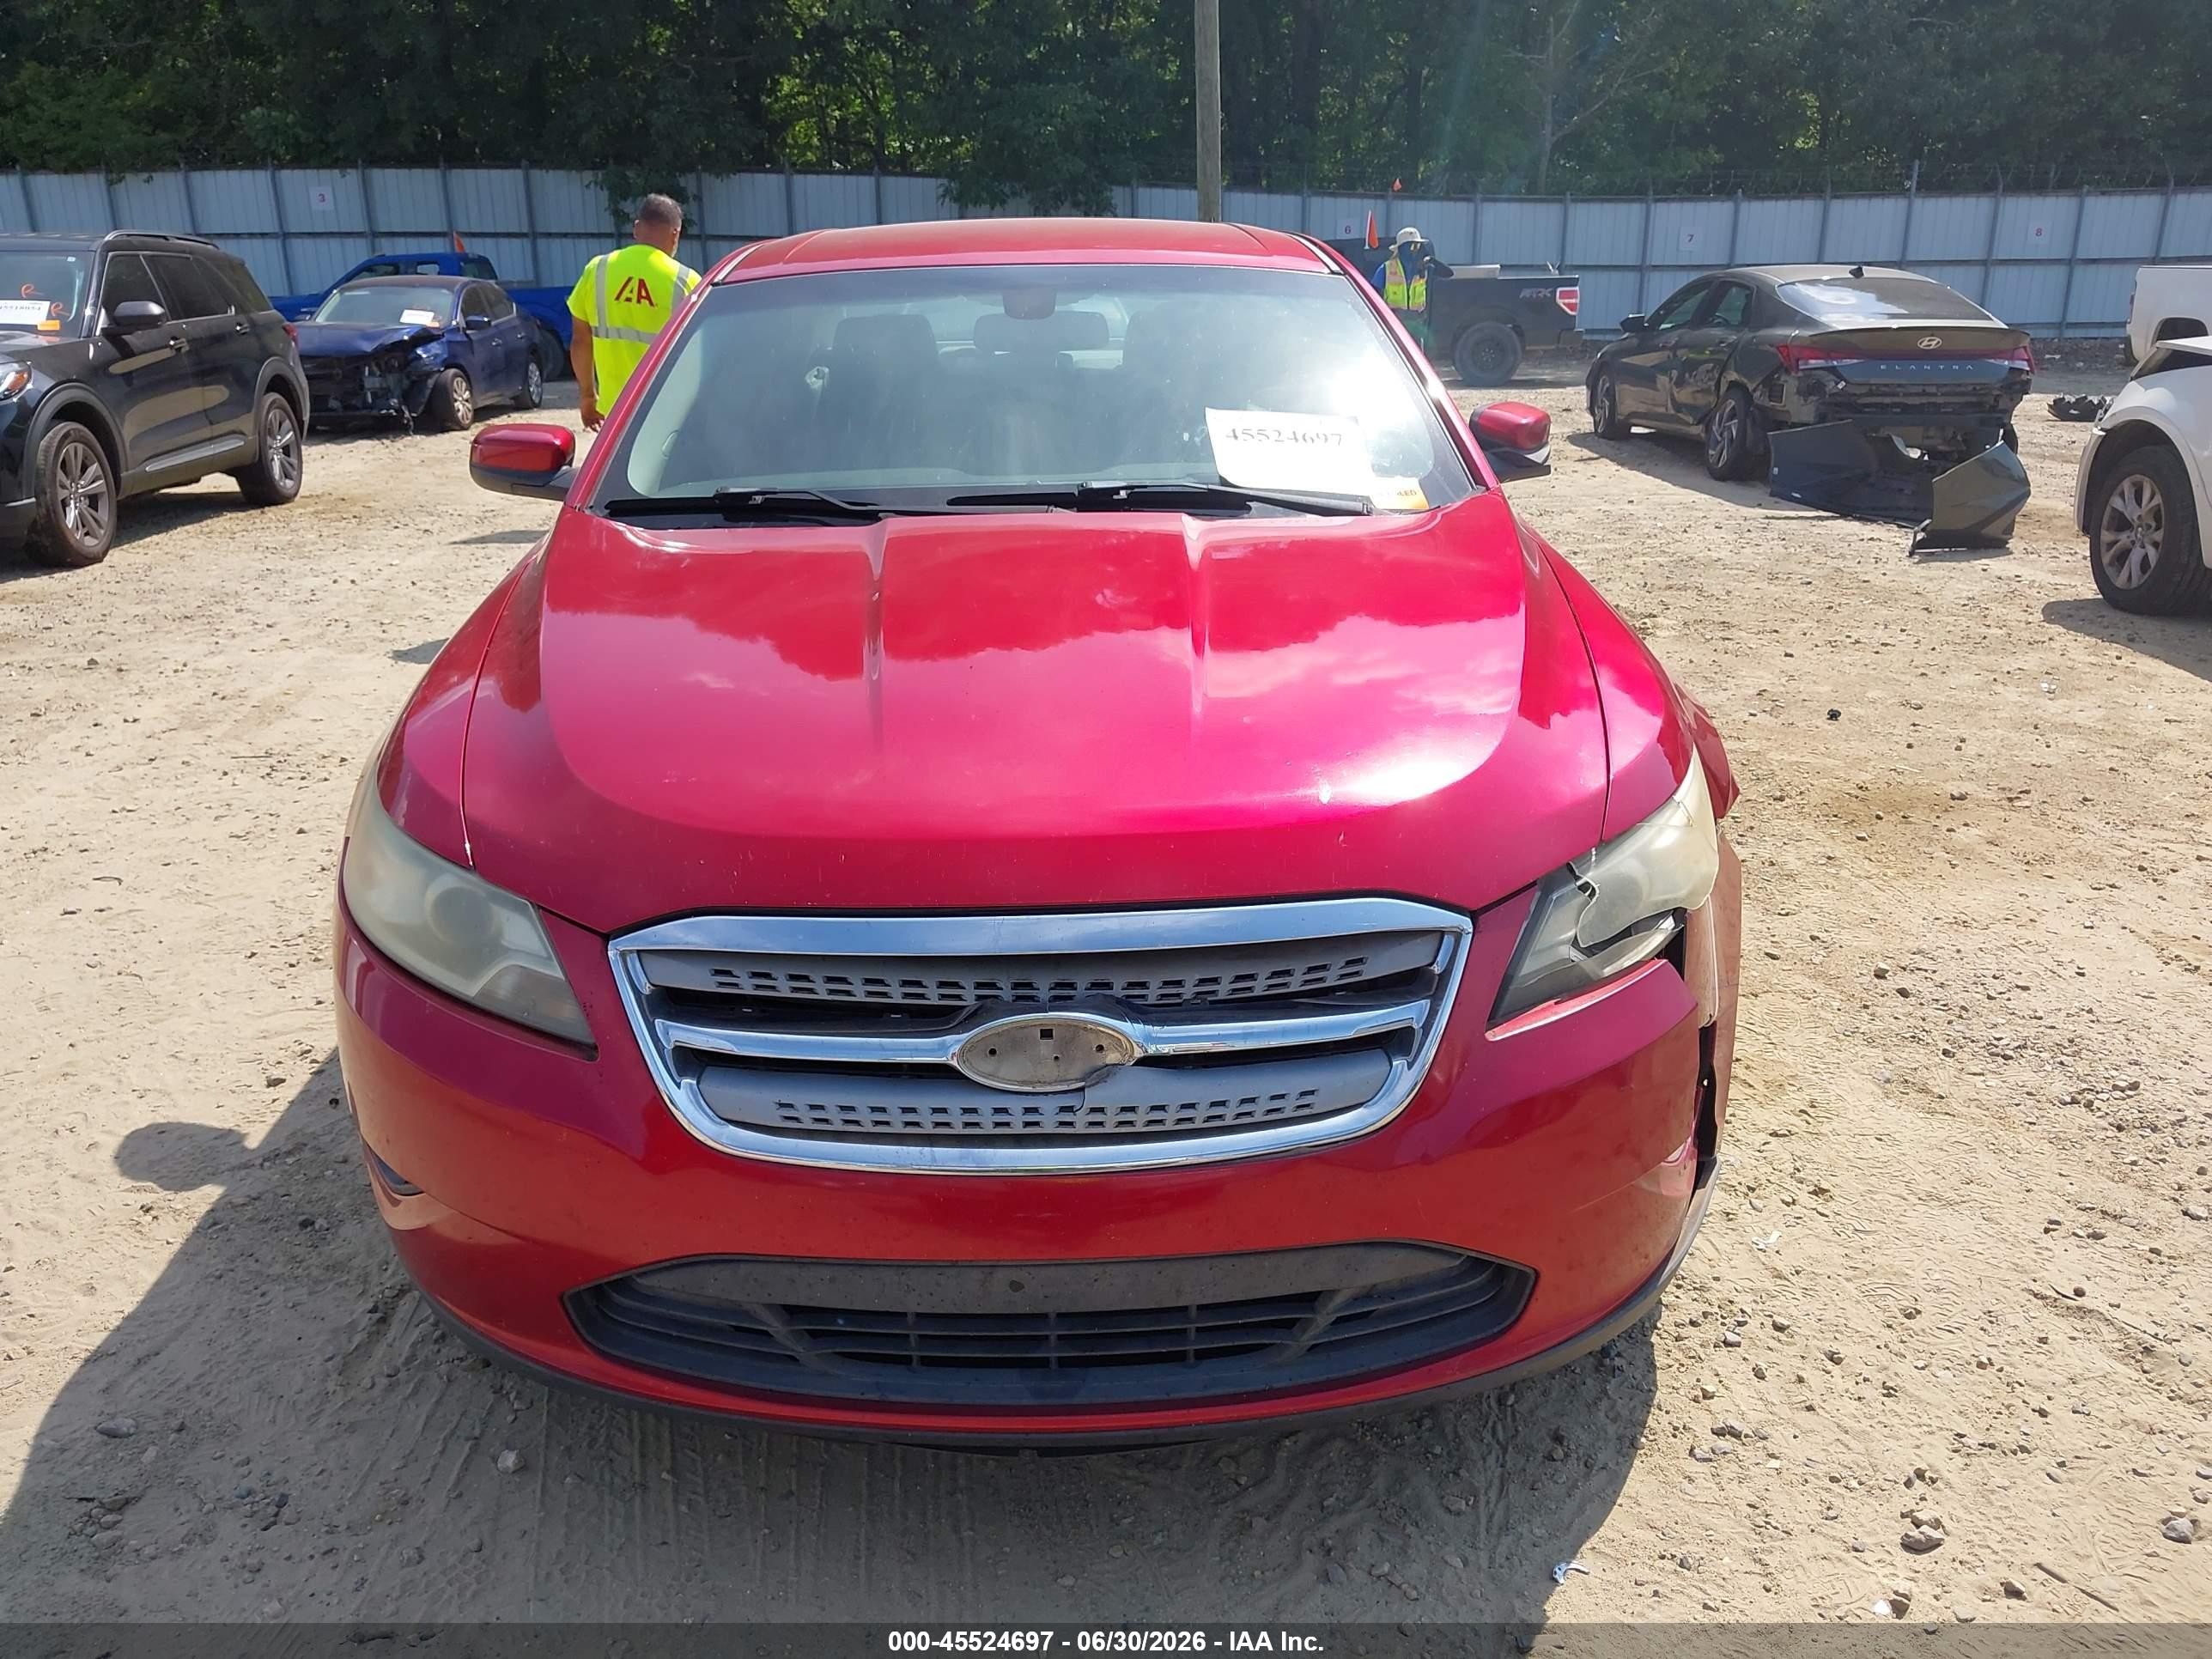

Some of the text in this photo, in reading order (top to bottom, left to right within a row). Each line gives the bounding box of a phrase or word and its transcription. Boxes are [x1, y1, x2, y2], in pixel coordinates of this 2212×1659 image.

[318, 193, 326, 203] 3
[2035, 228, 2043, 237] 8
[1687, 234, 1694, 243] 7
[1225, 428, 1342, 447] 45524697
